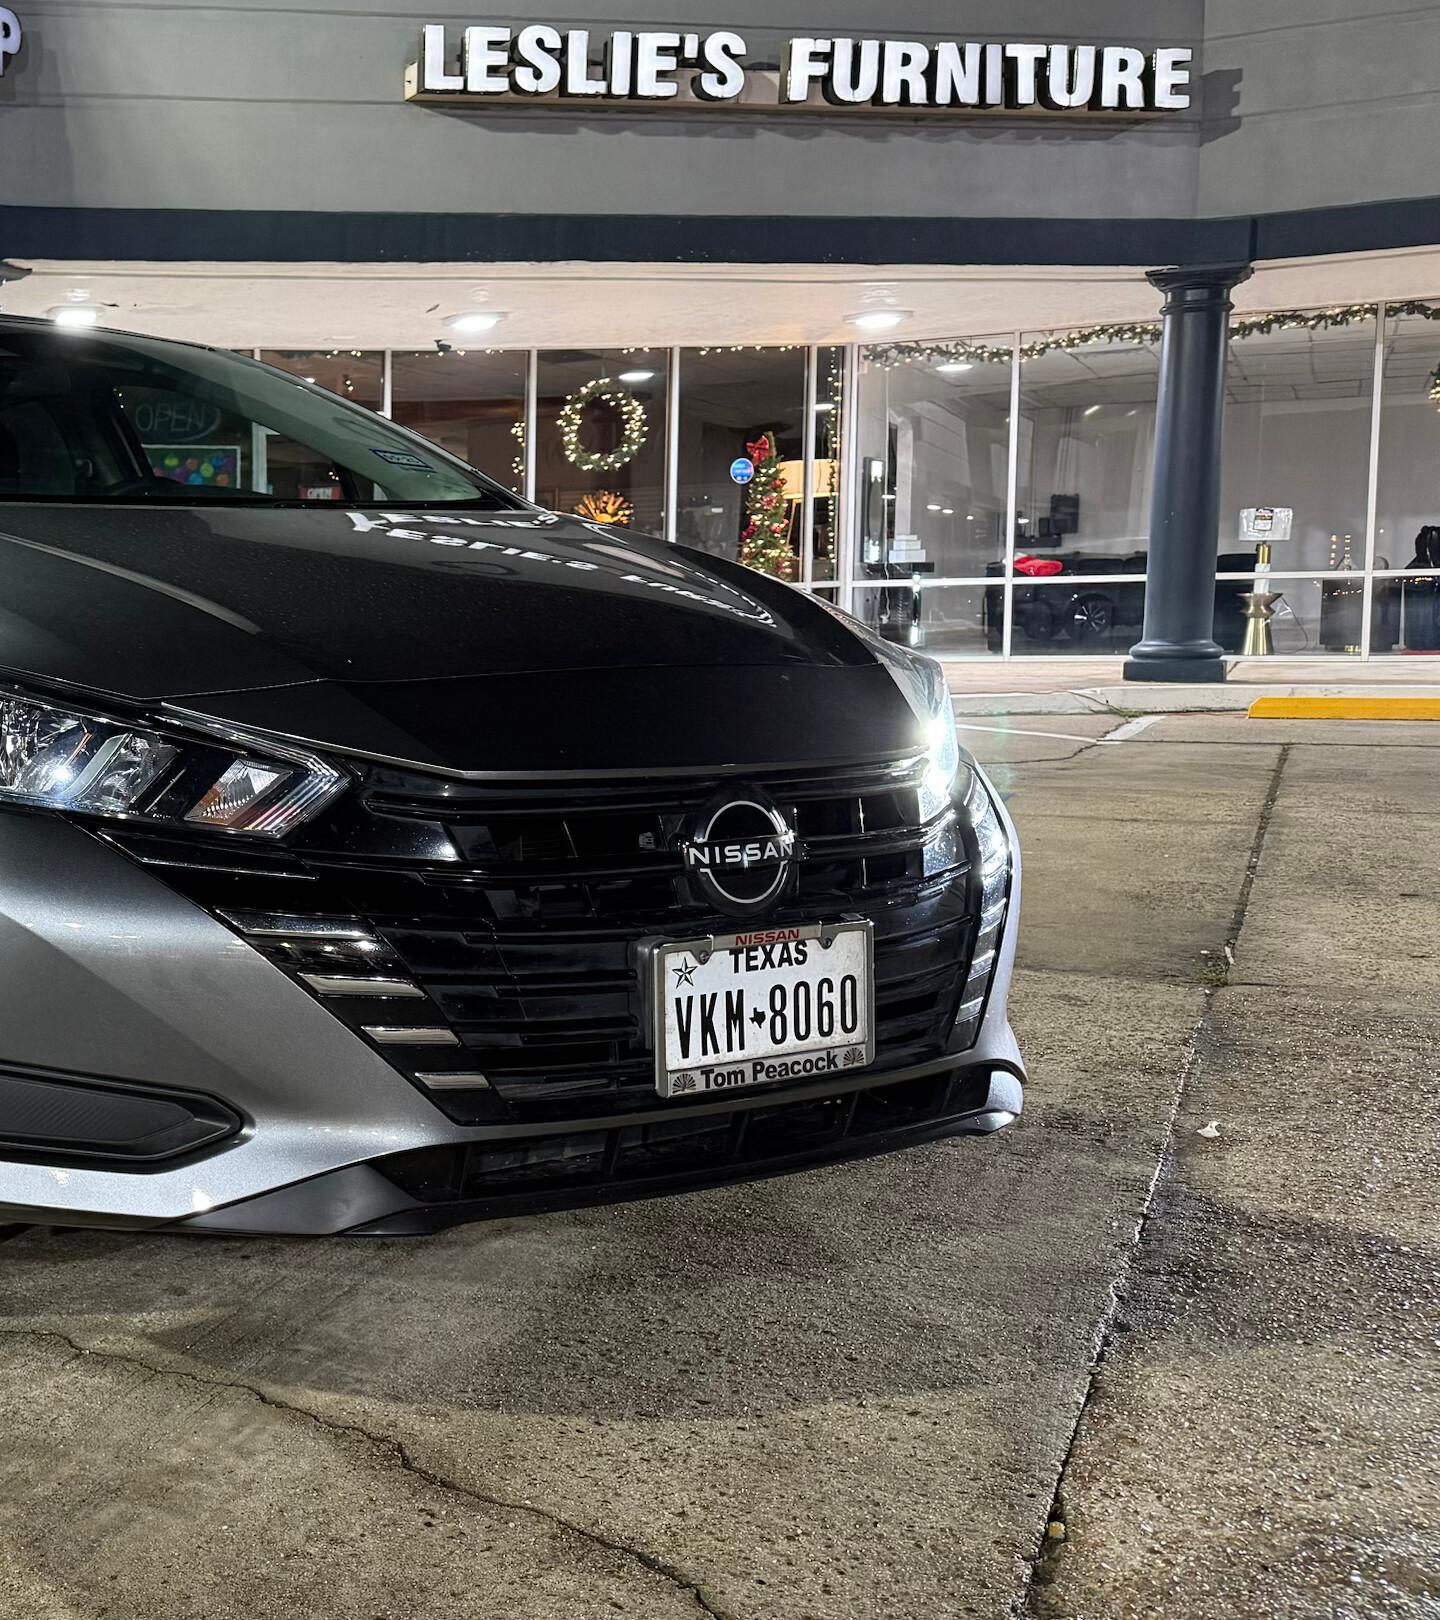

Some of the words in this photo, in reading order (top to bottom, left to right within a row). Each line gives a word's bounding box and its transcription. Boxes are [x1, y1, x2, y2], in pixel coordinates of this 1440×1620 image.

[422, 25, 747, 99] LESLIE'S
[788, 38, 1192, 110] FURNITURE
[689, 840, 794, 866] NISSAN
[735, 928, 800, 946] NISSAN
[729, 940, 808, 974] TEXAS
[675, 989, 745, 1060] VKM
[769, 974, 858, 1045] 8060
[701, 1069, 745, 1089] Tom
[752, 1050, 839, 1082] Peacock
